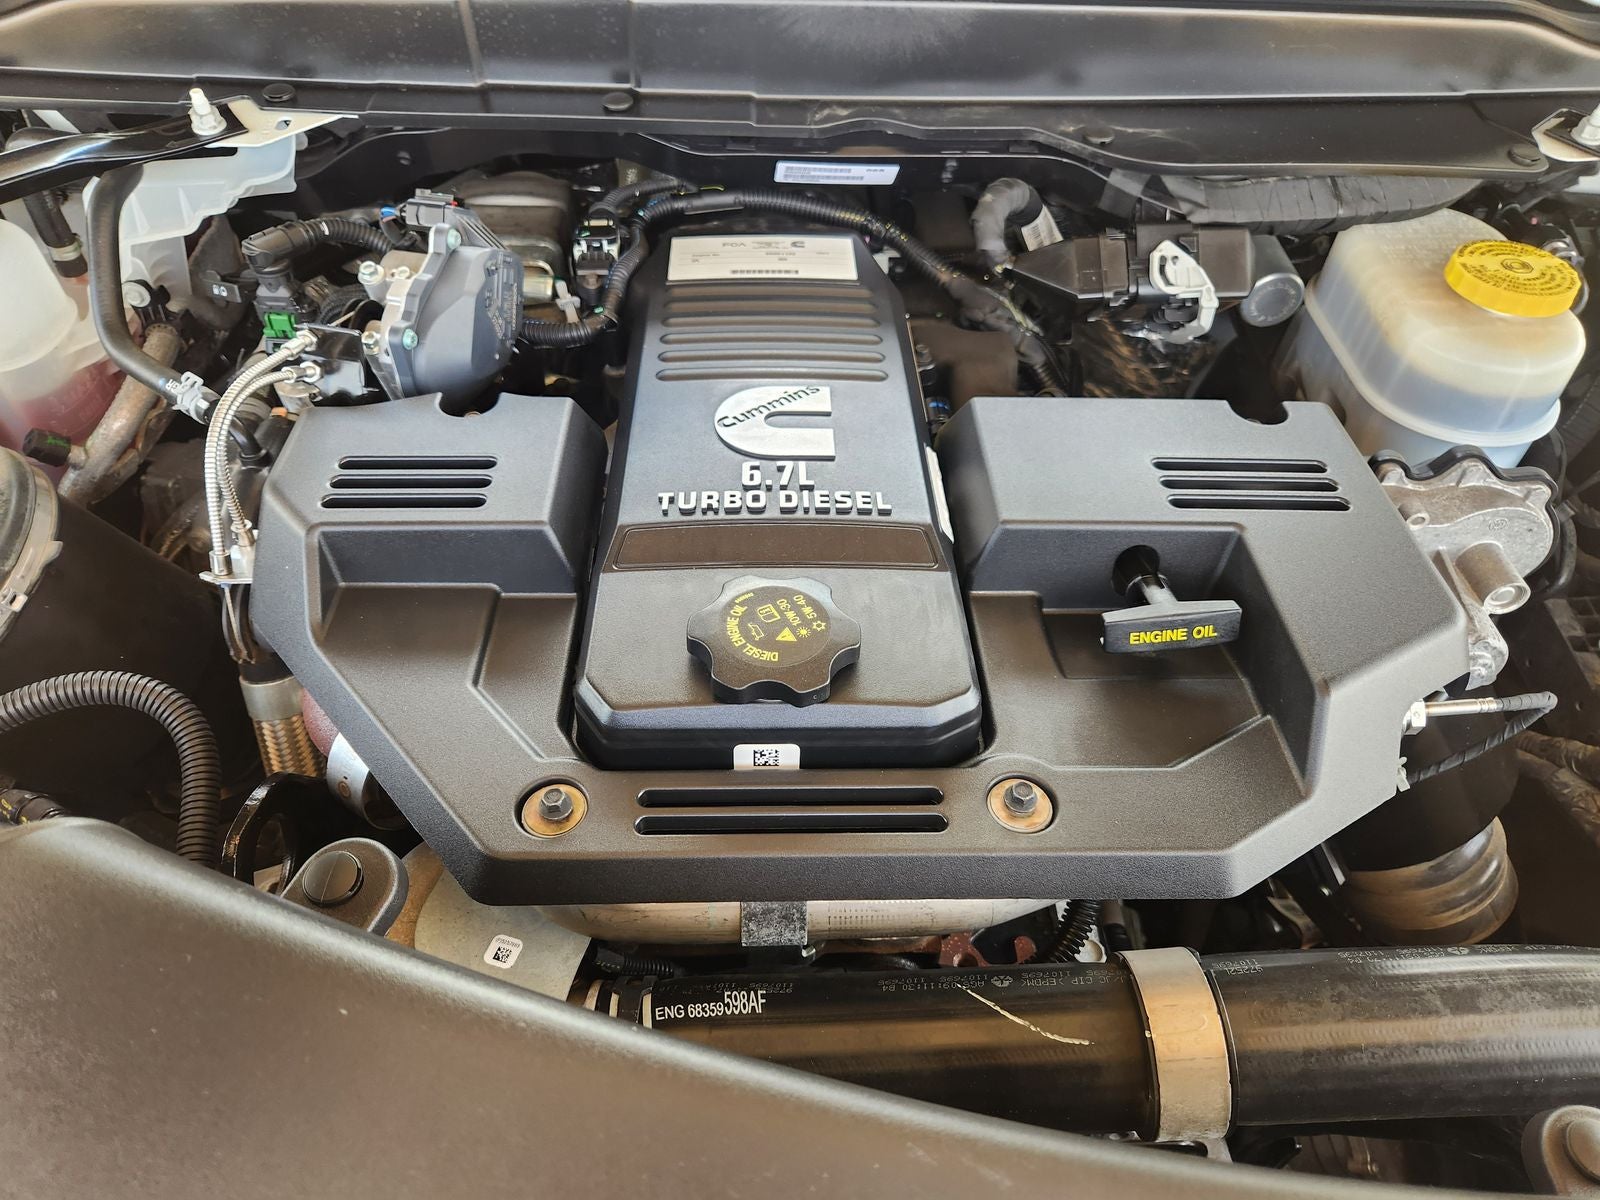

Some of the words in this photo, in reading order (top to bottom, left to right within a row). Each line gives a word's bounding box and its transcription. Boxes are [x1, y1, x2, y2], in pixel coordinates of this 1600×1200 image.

[716, 385, 820, 428] Cummins
[741, 461, 815, 489] 6.7L
[658, 490, 767, 514] TURBO
[779, 490, 892, 514] DIESEL
[730, 604, 748, 617] OIL
[776, 598, 801, 626] 10W-30
[793, 594, 817, 620] 5W-40
[727, 616, 746, 647] ENGINE
[1129, 628, 1188, 645] ENGINE
[1192, 625, 1217, 639] OIL
[743, 642, 779, 662] DIESEL
[655, 1004, 685, 1021] ENG
